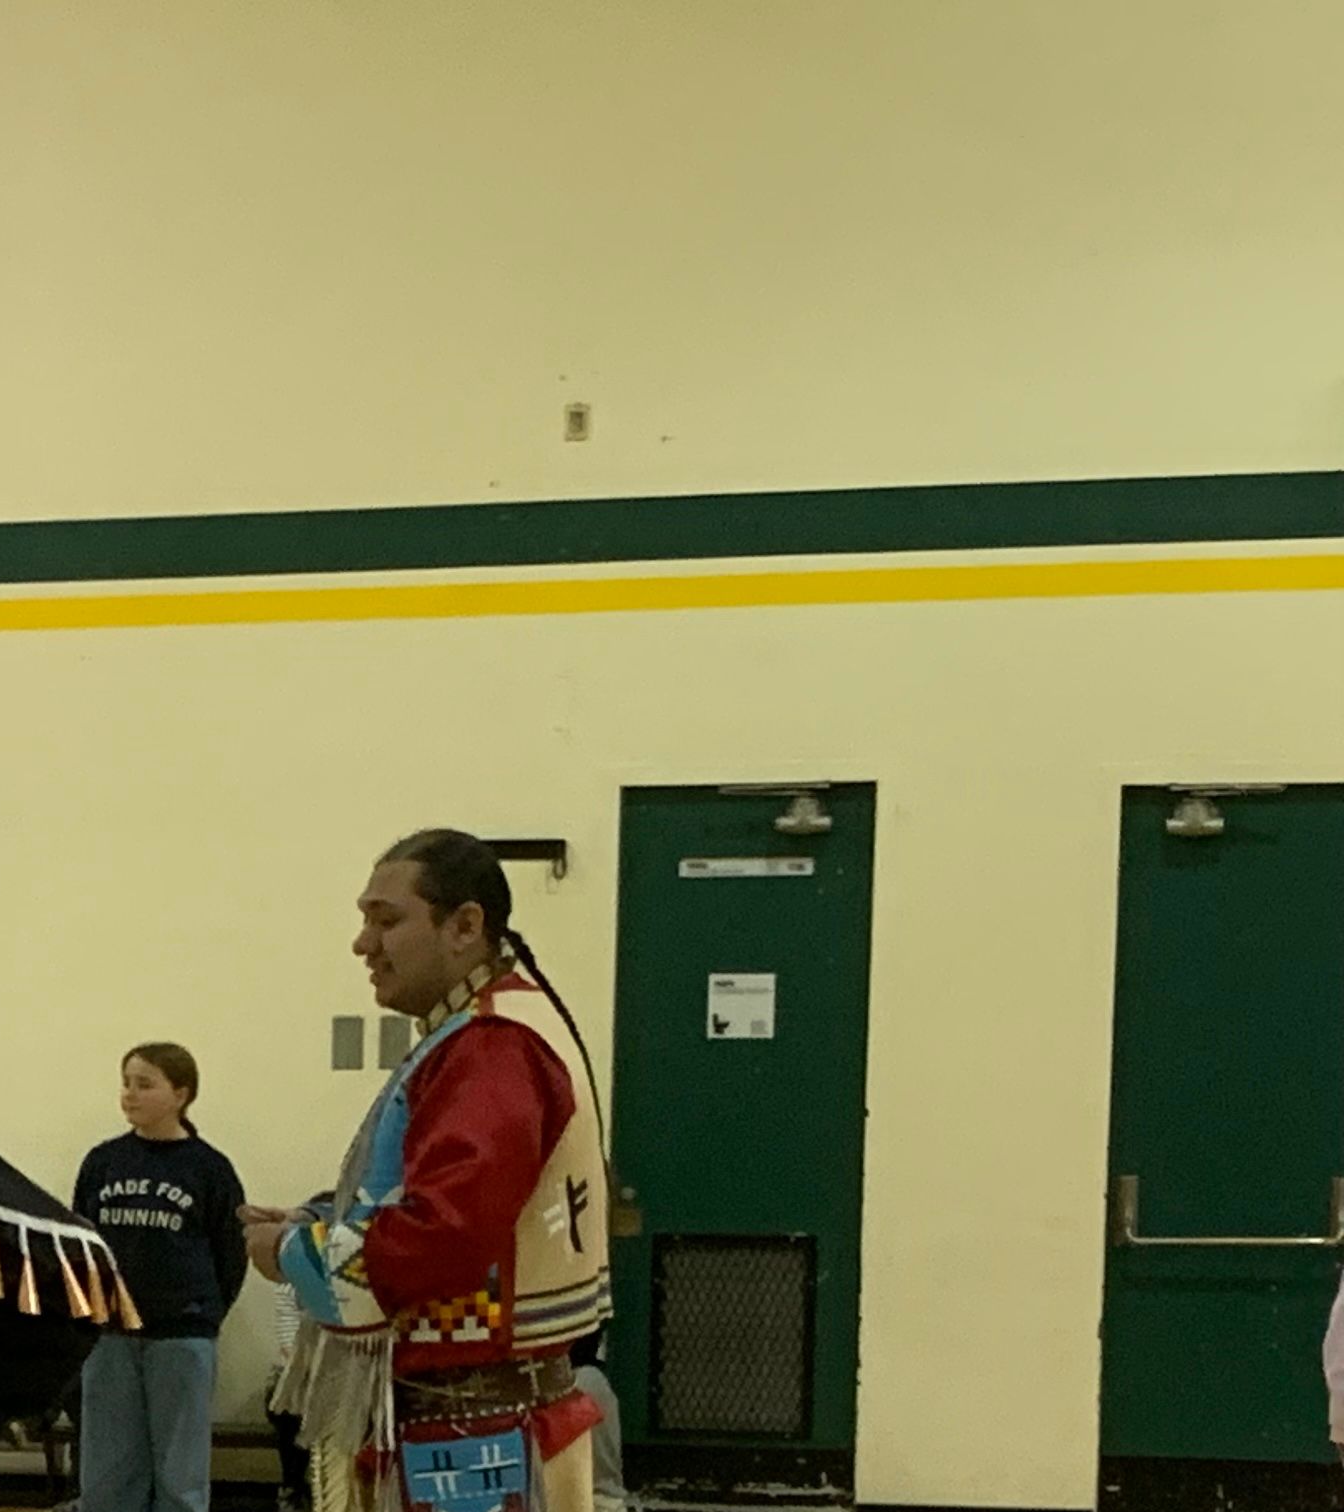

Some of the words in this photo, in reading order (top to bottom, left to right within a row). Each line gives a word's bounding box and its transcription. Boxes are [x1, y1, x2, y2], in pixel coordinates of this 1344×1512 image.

[99, 1178, 152, 1201] MADE
[156, 1181, 193, 1208] FOR
[99, 1208, 183, 1231] RUNNING
